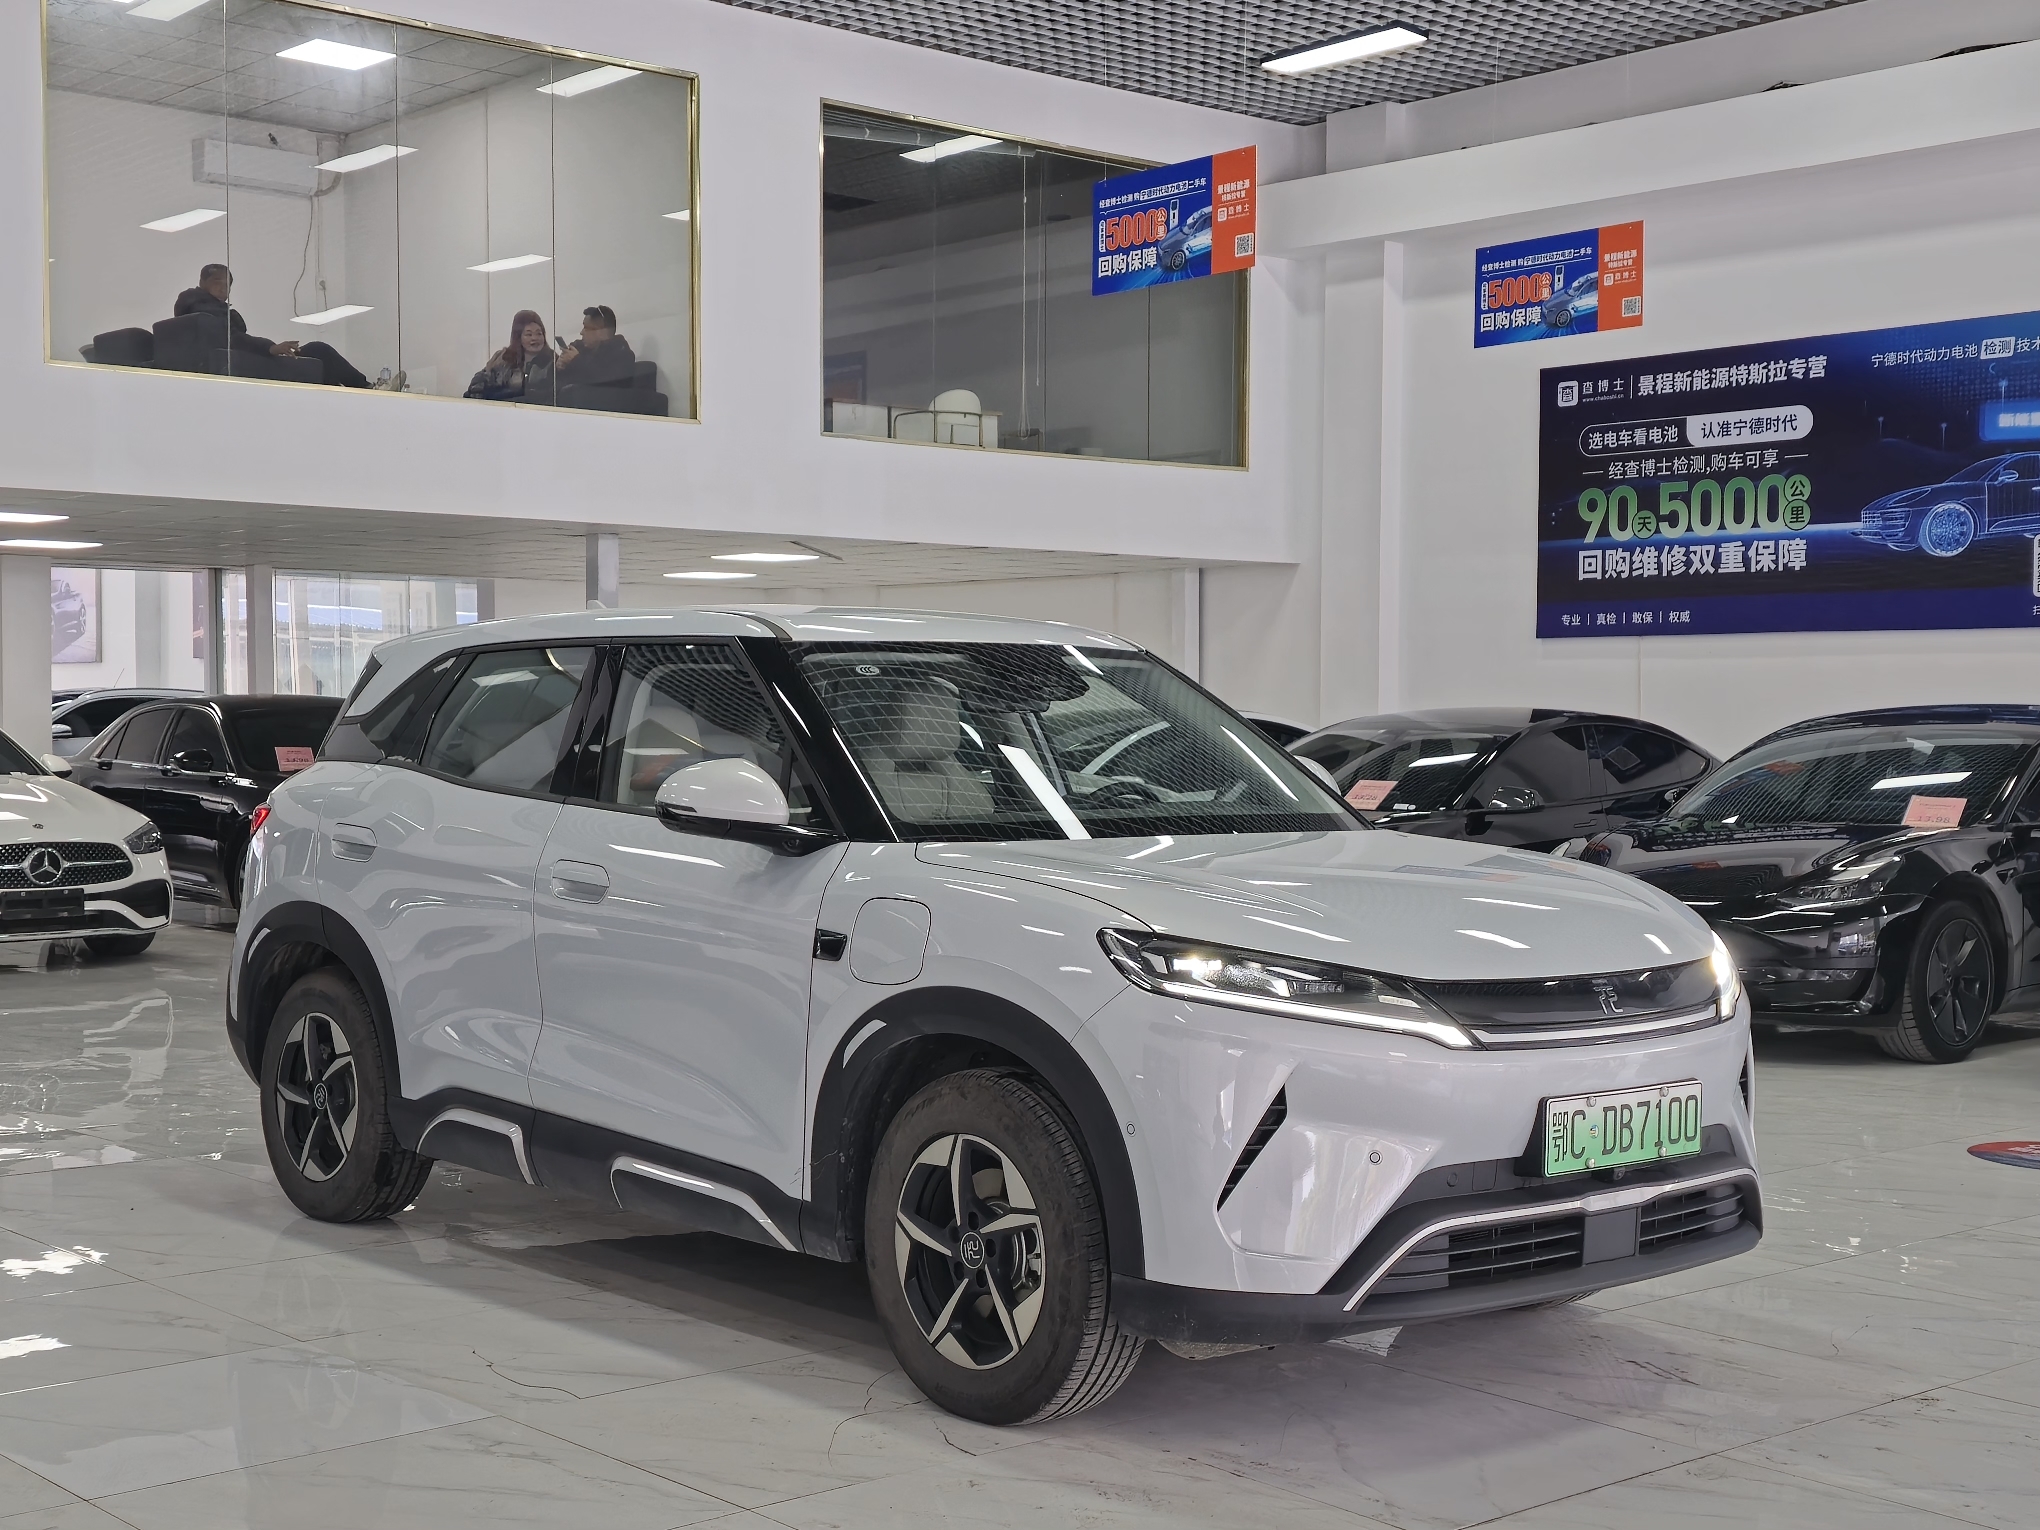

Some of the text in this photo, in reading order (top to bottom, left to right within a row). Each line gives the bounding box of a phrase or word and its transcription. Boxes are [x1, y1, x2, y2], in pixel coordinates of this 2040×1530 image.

[1098, 246, 1158, 278] 回购保障
[1480, 305, 1542, 332] 回购保障
[1637, 355, 1828, 396] 景程新能源特斯拉专营
[1588, 414, 1798, 450] 选电车看电池 认准宁德时代
[1578, 538, 1807, 580] 回购维修双重保障
[1561, 610, 1691, 626] 专业 真检 敢保 权威
[1602, 1094, 1698, 1156] DB7100
